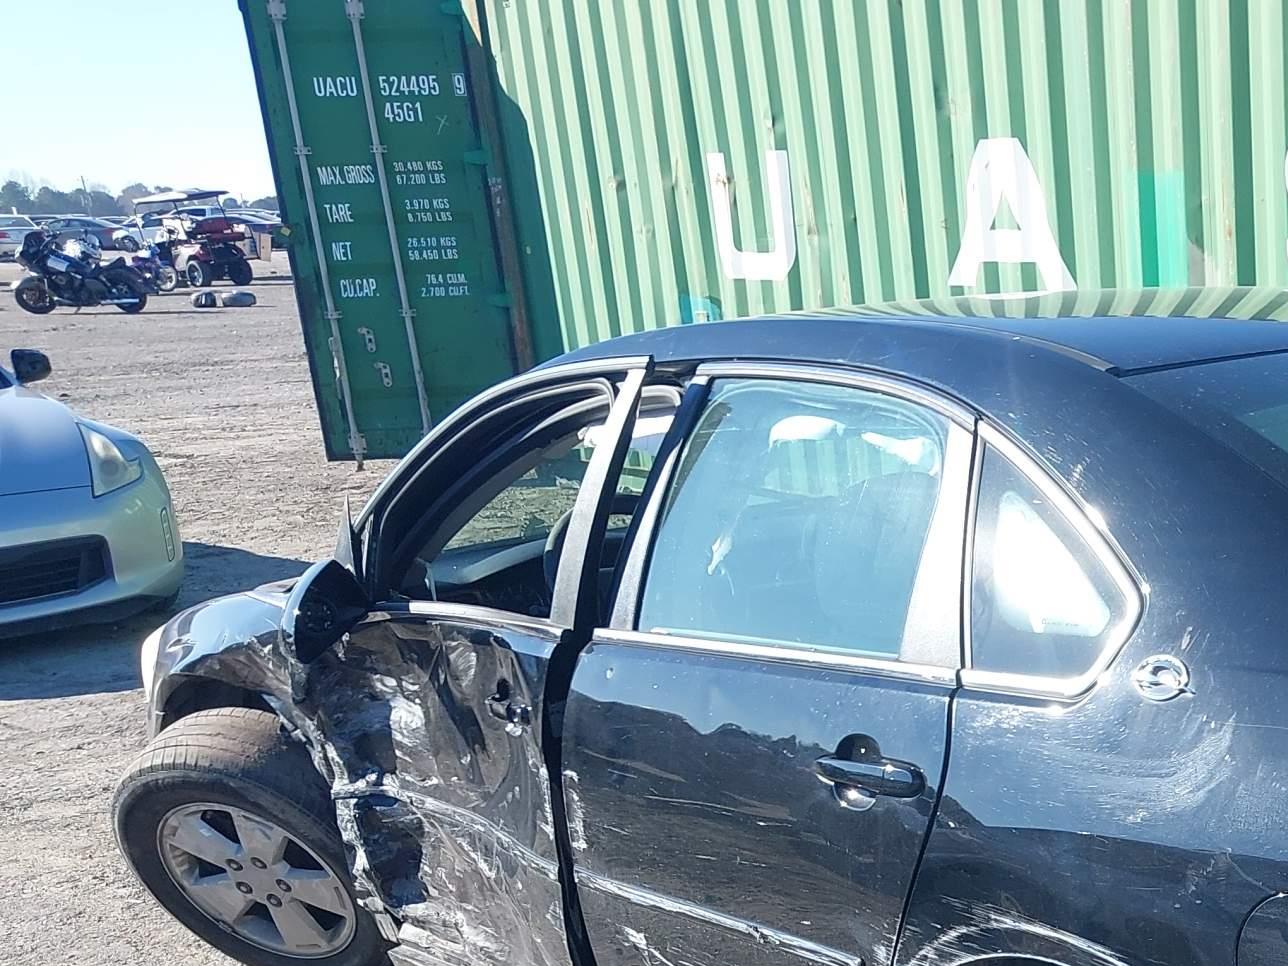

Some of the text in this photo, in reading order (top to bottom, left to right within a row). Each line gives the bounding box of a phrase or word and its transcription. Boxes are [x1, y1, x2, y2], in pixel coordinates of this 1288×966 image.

[312, 74, 466, 97] UACU 524495 9
[384, 102, 423, 122] 45G1
[392, 160, 443, 171] 30.480 KGS
[396, 173, 446, 185] 67.200 LBS
[405, 198, 450, 210] 3.970 KGS
[323, 203, 354, 223] TARE
[435, 212, 453, 222] LBS
[407, 236, 457, 248] 26.510 KGS
[331, 242, 352, 261] NET
[408, 249, 458, 261] 58.450 LBS
[425, 273, 443, 284] 76.4
[421, 287, 445, 297] 2.700
